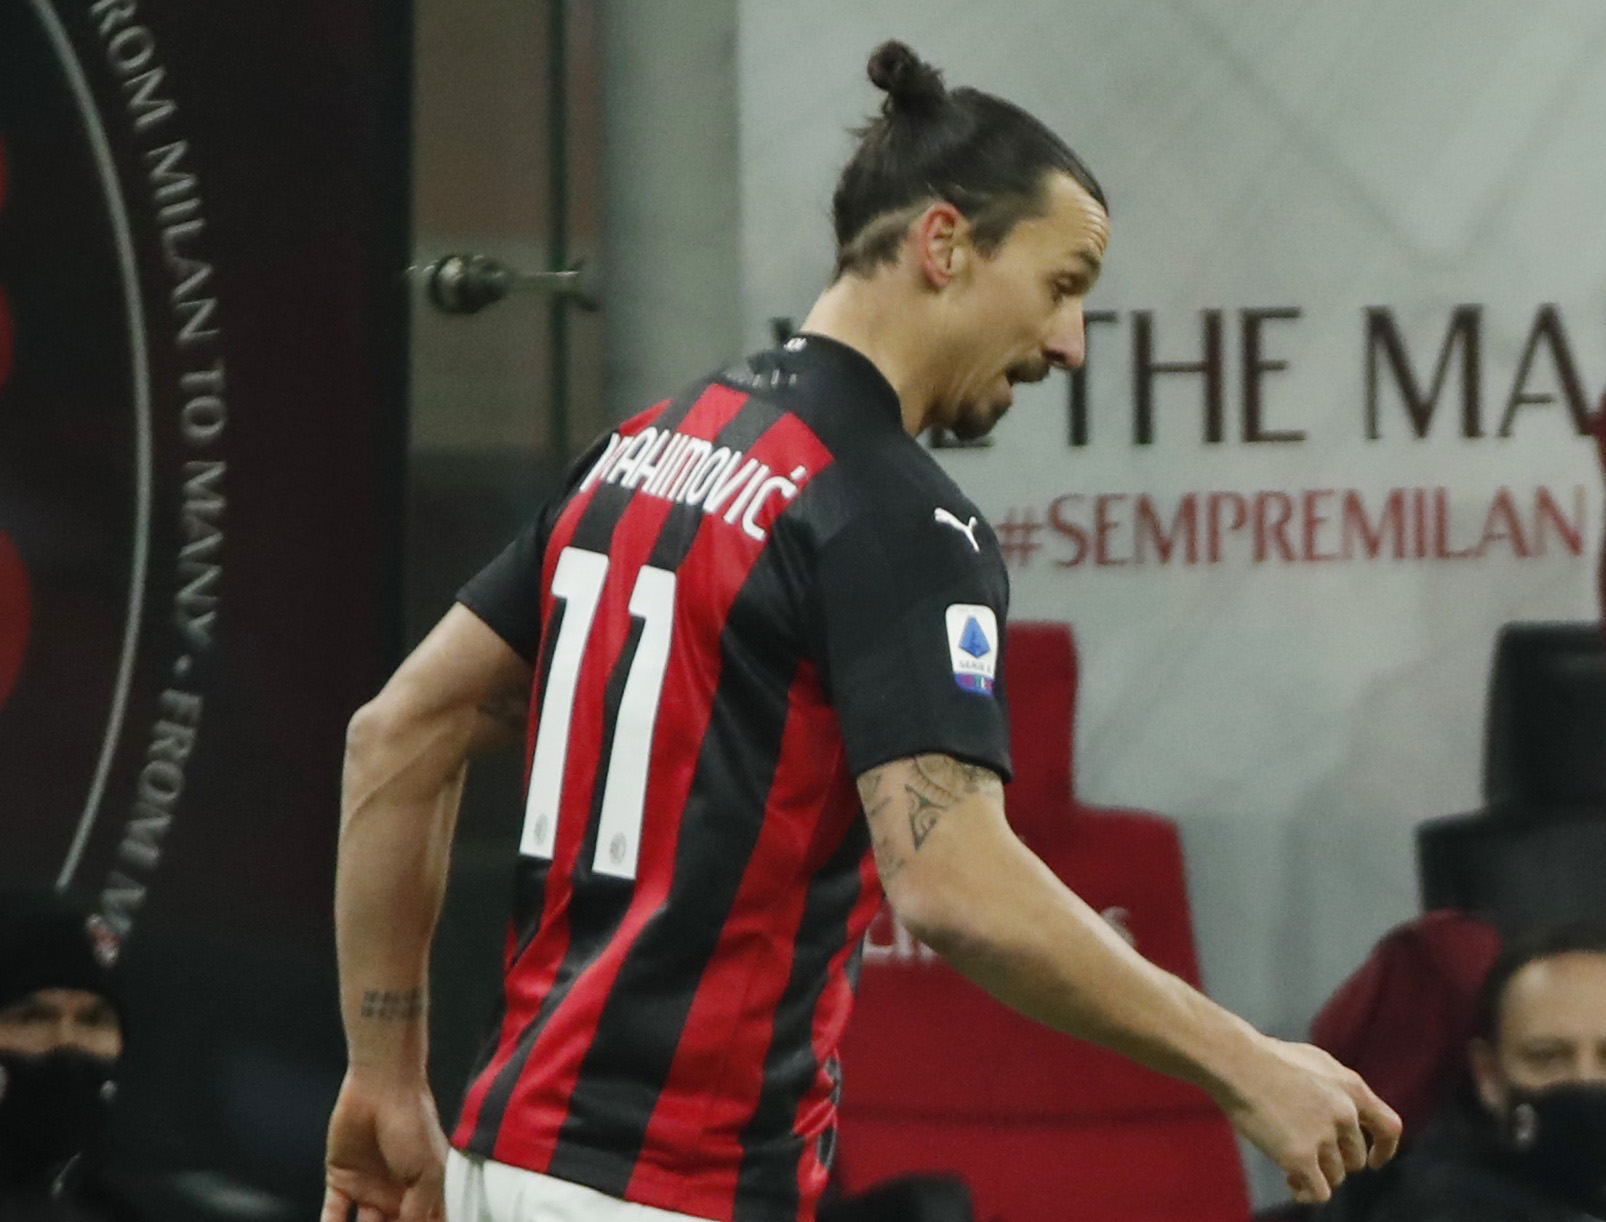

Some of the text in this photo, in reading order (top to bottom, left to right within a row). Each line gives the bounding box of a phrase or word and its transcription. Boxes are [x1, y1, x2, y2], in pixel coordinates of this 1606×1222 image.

[89, 0, 178, 131] ROM
[145, 138, 222, 343] MILAN
[179, 356, 227, 440] TO
[174, 459, 228, 648] MANY
[996, 484, 1588, 570] #SEMPREMILAN
[117, 687, 204, 868] FROM
[518, 546, 677, 880] 11
